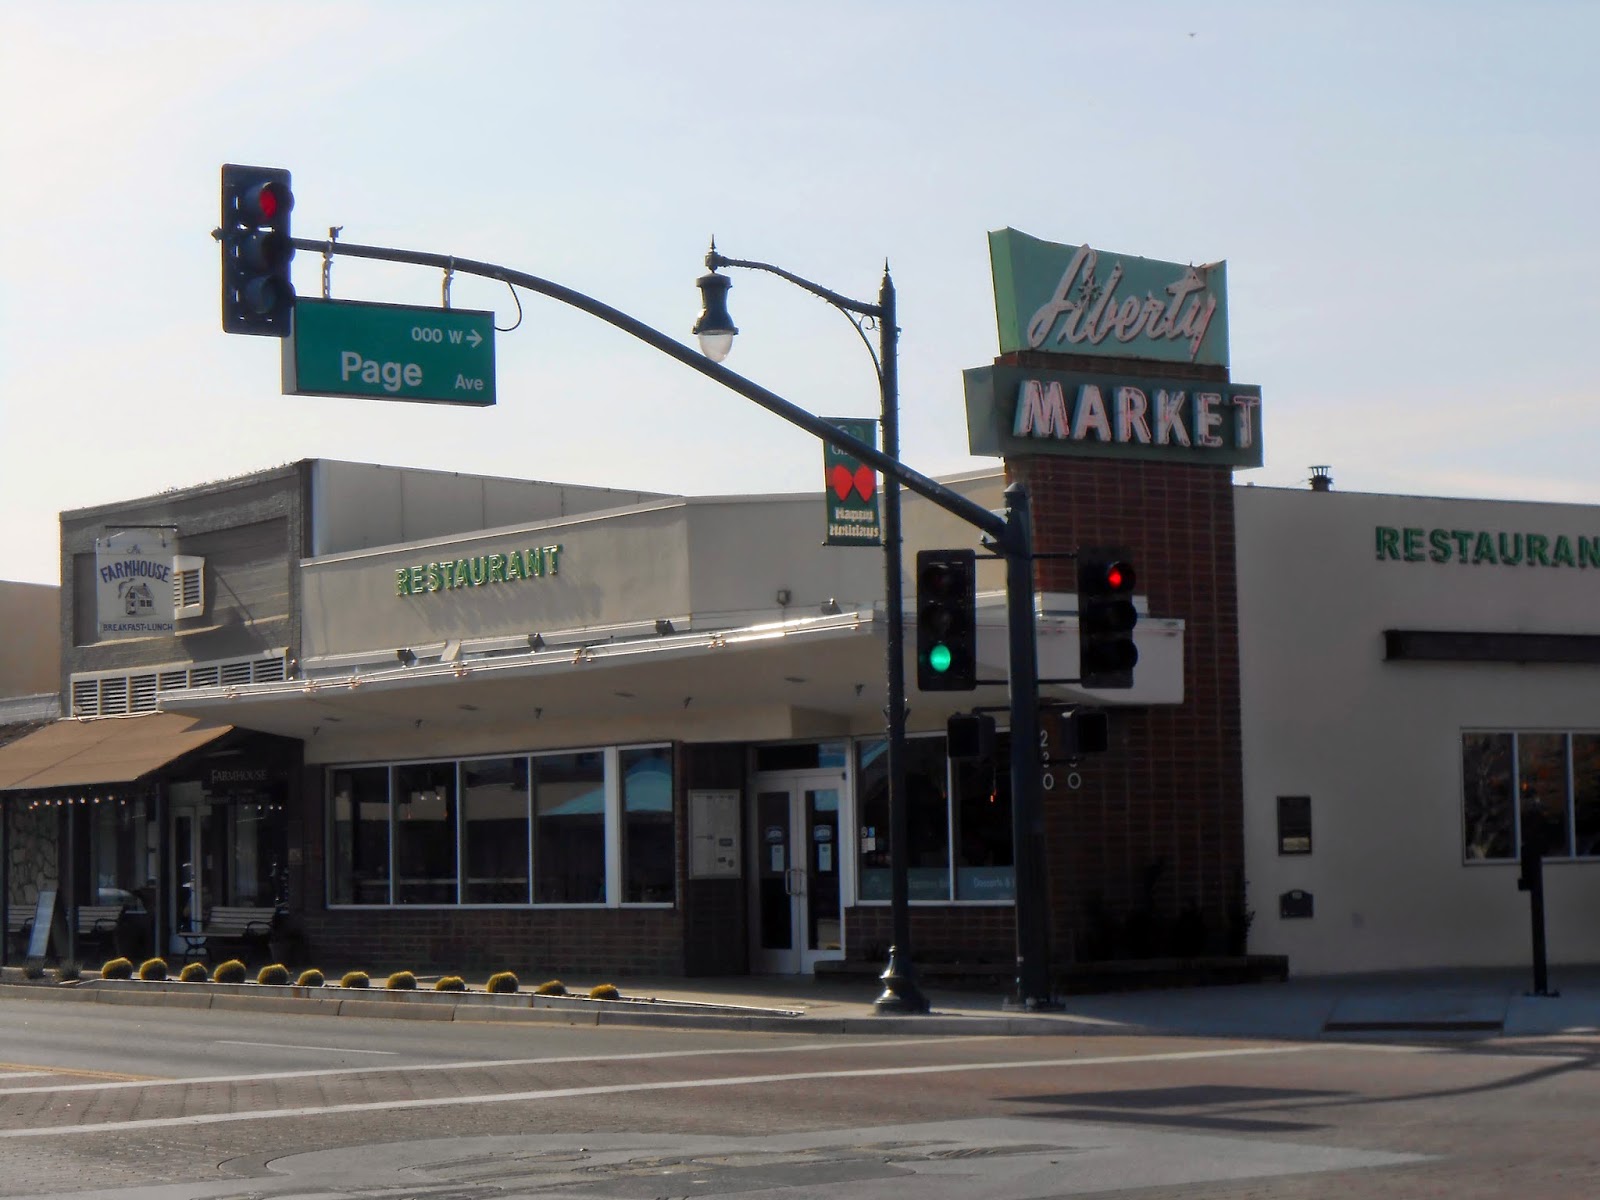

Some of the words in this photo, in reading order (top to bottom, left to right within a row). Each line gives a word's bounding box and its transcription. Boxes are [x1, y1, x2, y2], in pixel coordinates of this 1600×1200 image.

[1027, 243, 1217, 363] Liberty
[411, 326, 443, 344] 000
[449, 330, 463, 344] W
[340, 350, 423, 392] Page
[455, 374, 484, 391] Ave
[1013, 379, 1261, 449] MARKET
[829, 524, 880, 538] Holidays
[835, 506, 875, 523] Happy
[1375, 525, 1600, 569] RESTAURAN
[100, 560, 172, 584] FARMHOUSE
[395, 544, 563, 597] RESTAURANT
